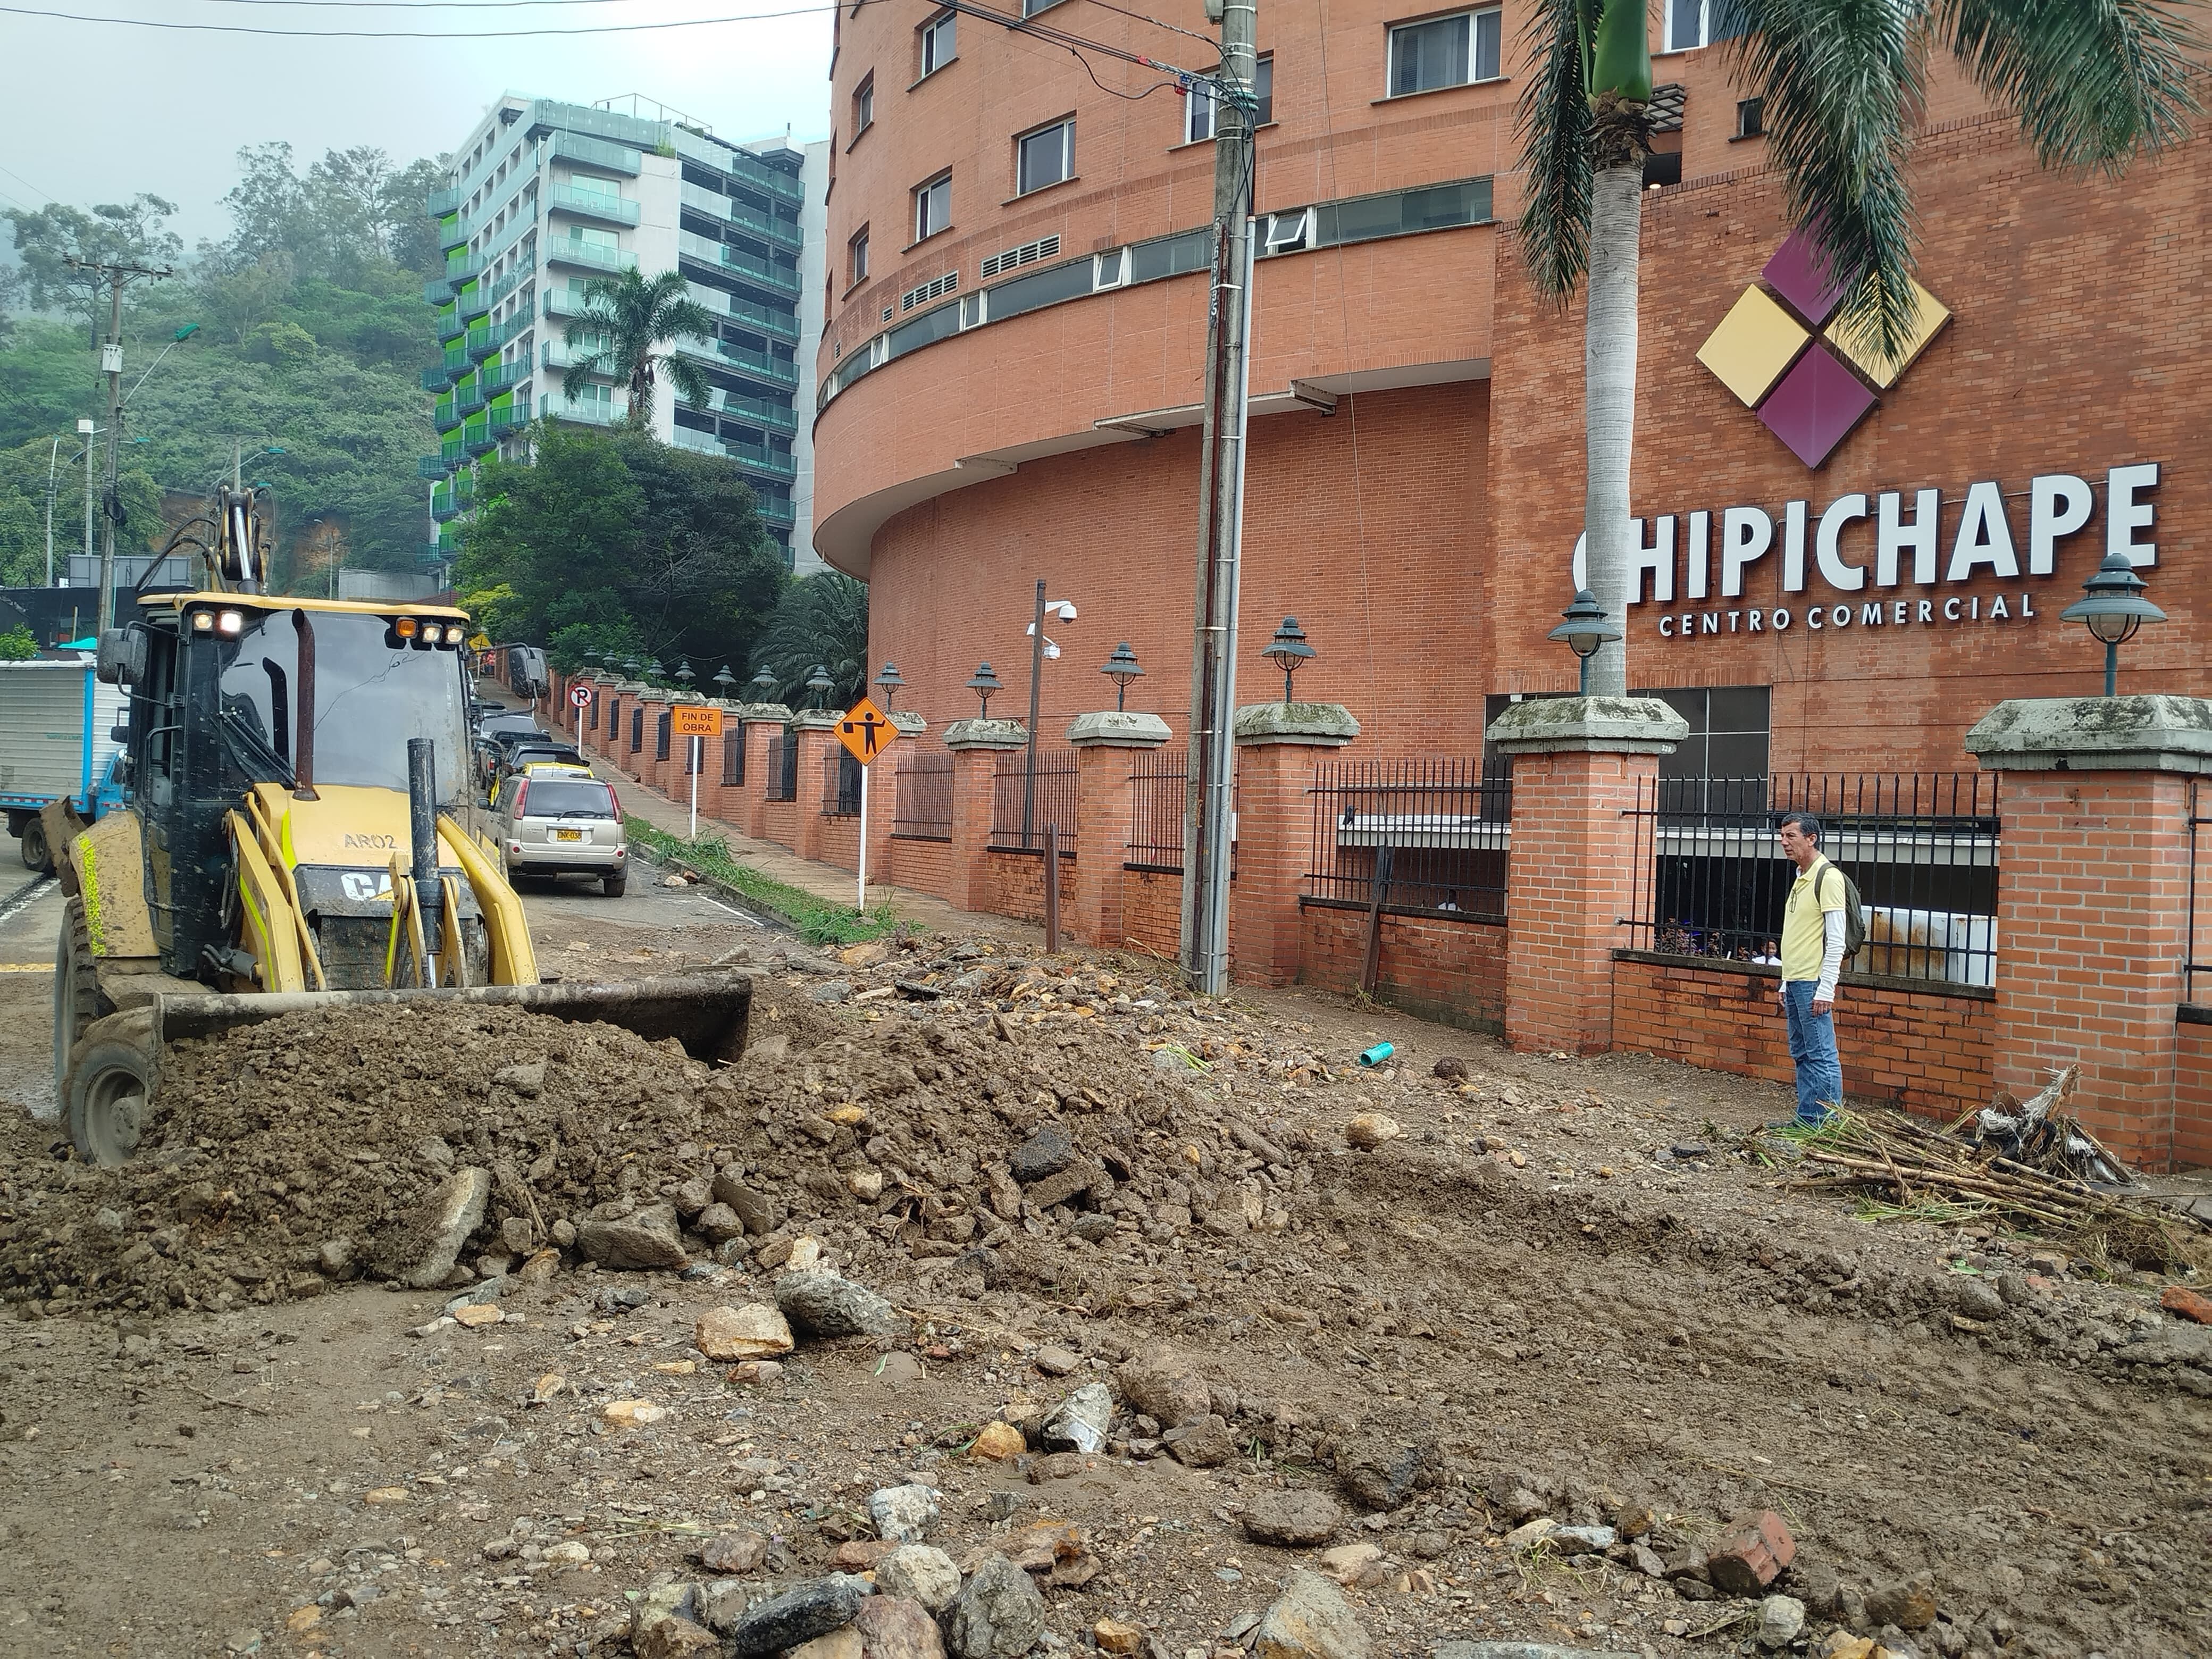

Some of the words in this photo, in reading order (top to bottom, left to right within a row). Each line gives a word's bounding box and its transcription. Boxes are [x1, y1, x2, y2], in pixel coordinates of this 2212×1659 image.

[1658, 607, 1791, 636] CENTRO
[1807, 593, 2035, 629] COMERCIAL
[577, 689, 588, 704] P
[683, 723, 711, 732] OBRA
